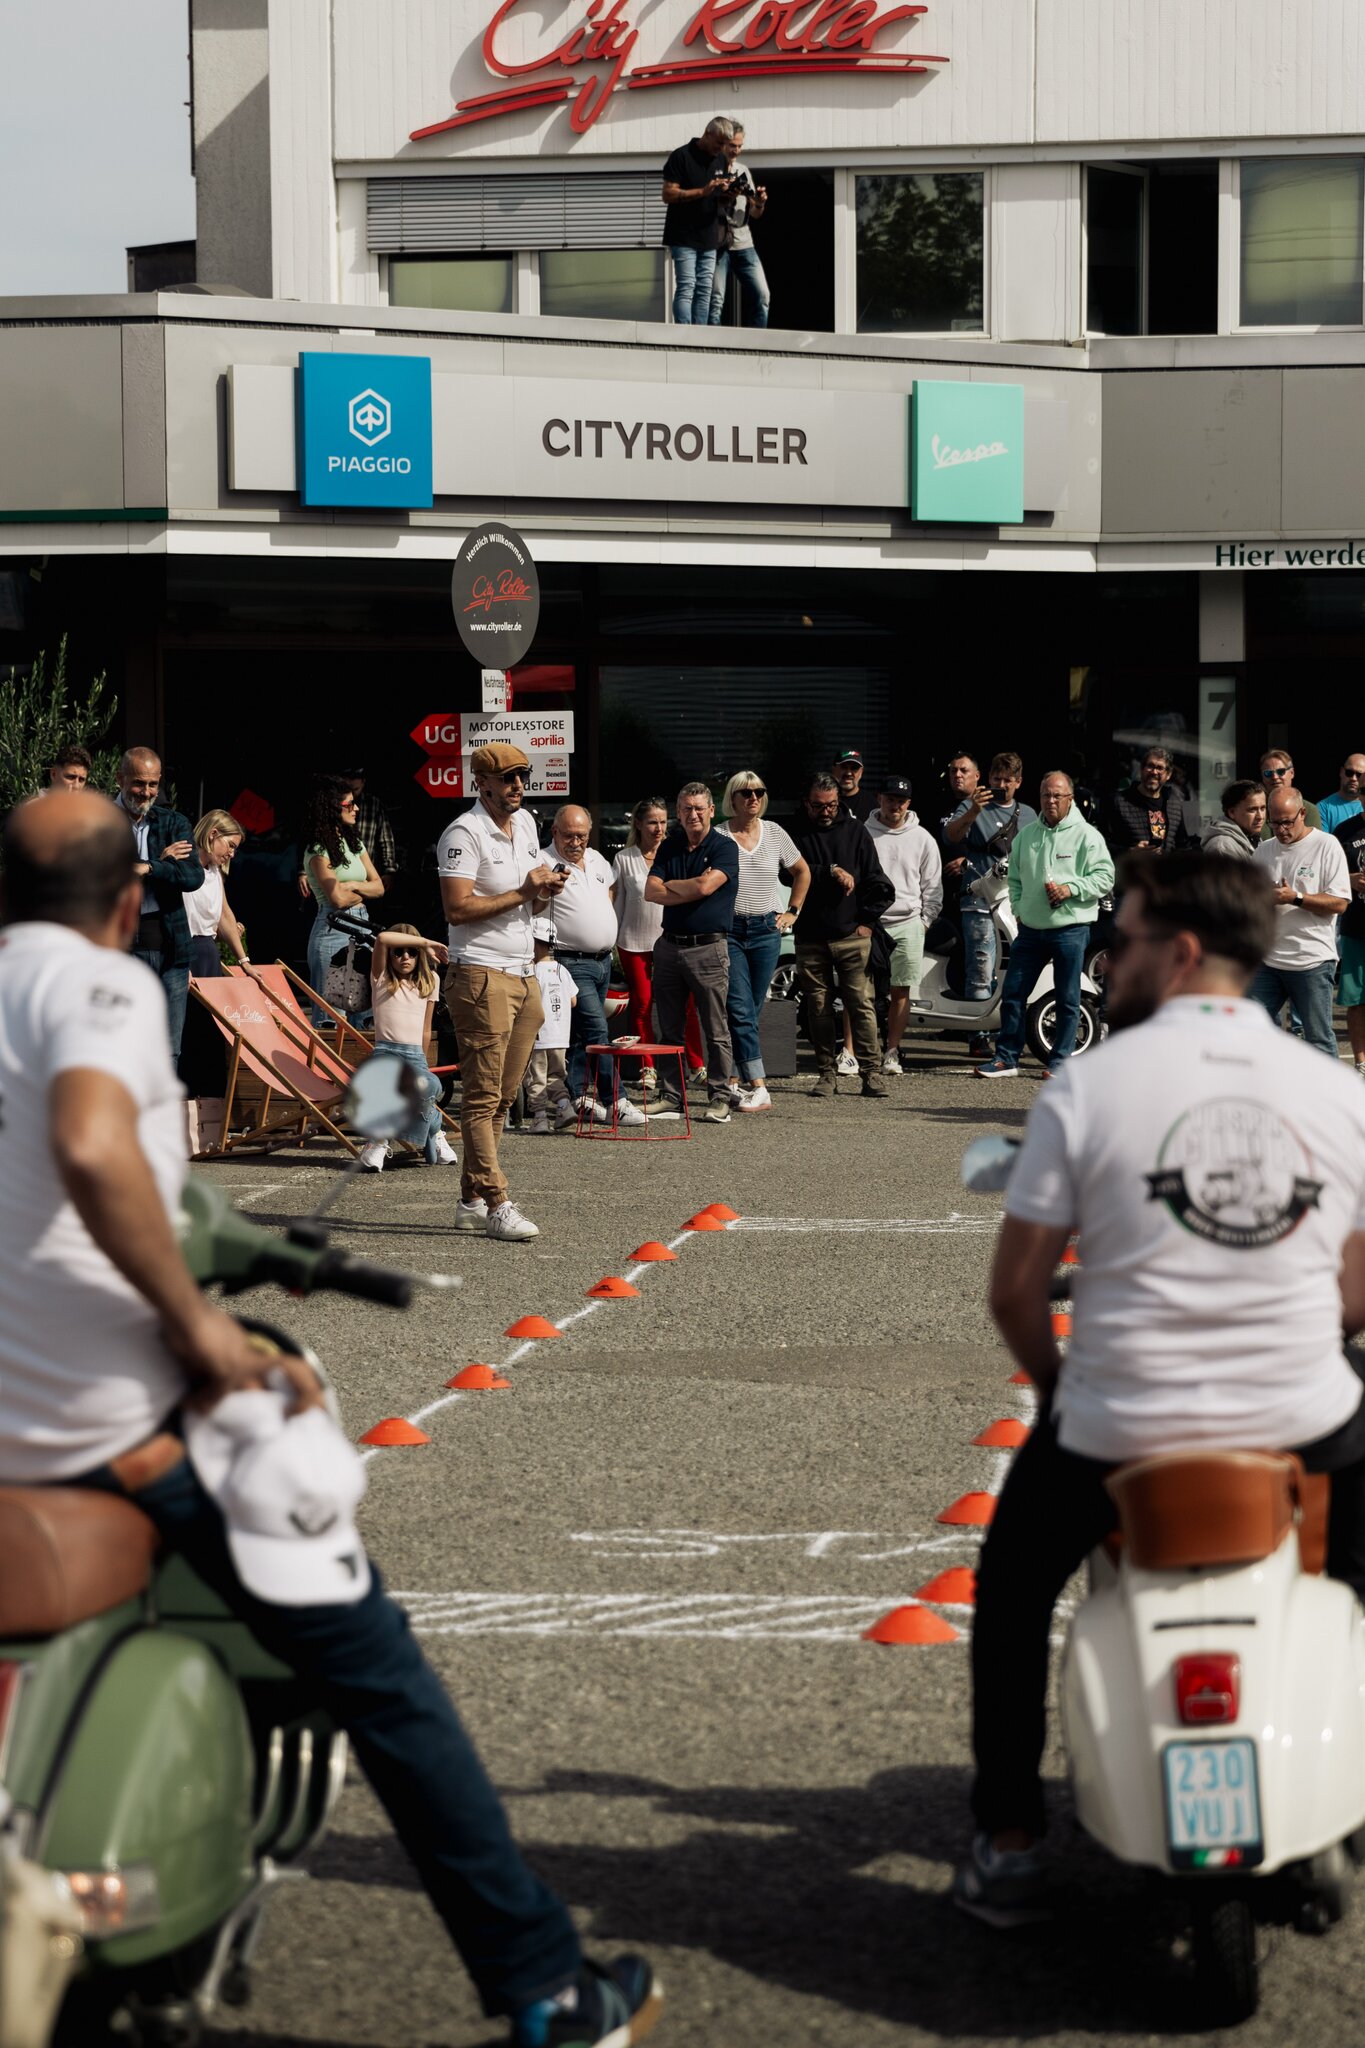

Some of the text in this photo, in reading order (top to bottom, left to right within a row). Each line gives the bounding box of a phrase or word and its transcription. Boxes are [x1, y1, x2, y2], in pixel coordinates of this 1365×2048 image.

[541, 418, 809, 466] CITYROLLER
[931, 433, 1009, 470] Vespa
[327, 456, 412, 474] PIAGGIO
[465, 533, 525, 566] Herzlich Willkommen
[1215, 542, 1275, 567] Hier
[472, 569, 531, 612] City Roller
[470, 621, 523, 634] www.cityroller.de
[468, 720, 565, 732] MOTOPLEXSTORE
[1207, 691, 1237, 731] 7
[530, 734, 565, 748] aprilia
[1177, 1748, 1245, 1792] 230
